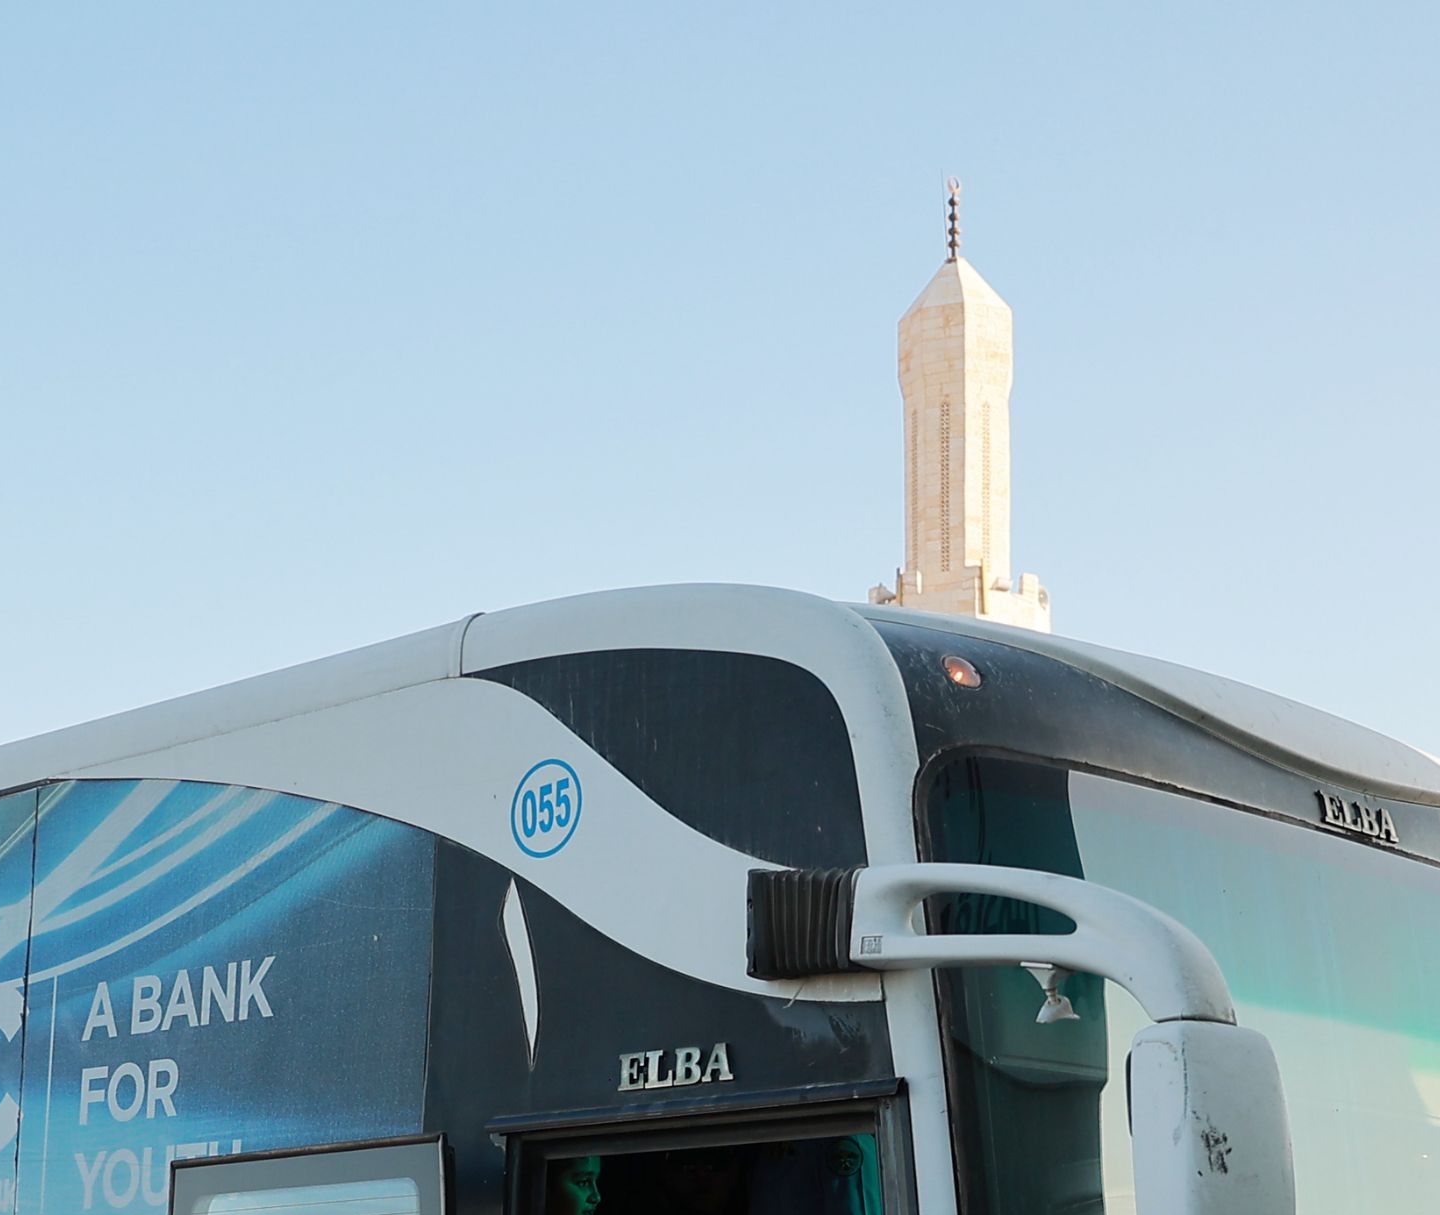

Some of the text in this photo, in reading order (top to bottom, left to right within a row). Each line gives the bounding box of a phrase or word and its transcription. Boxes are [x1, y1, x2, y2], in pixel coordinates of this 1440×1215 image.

[522, 777, 571, 838] 055
[1316, 792, 1399, 843] ELBA
[81, 956, 276, 1042] A BANK
[79, 1058, 179, 1126] FOR
[617, 1042, 734, 1092] ELBA
[74, 1139, 242, 1212] YOU
